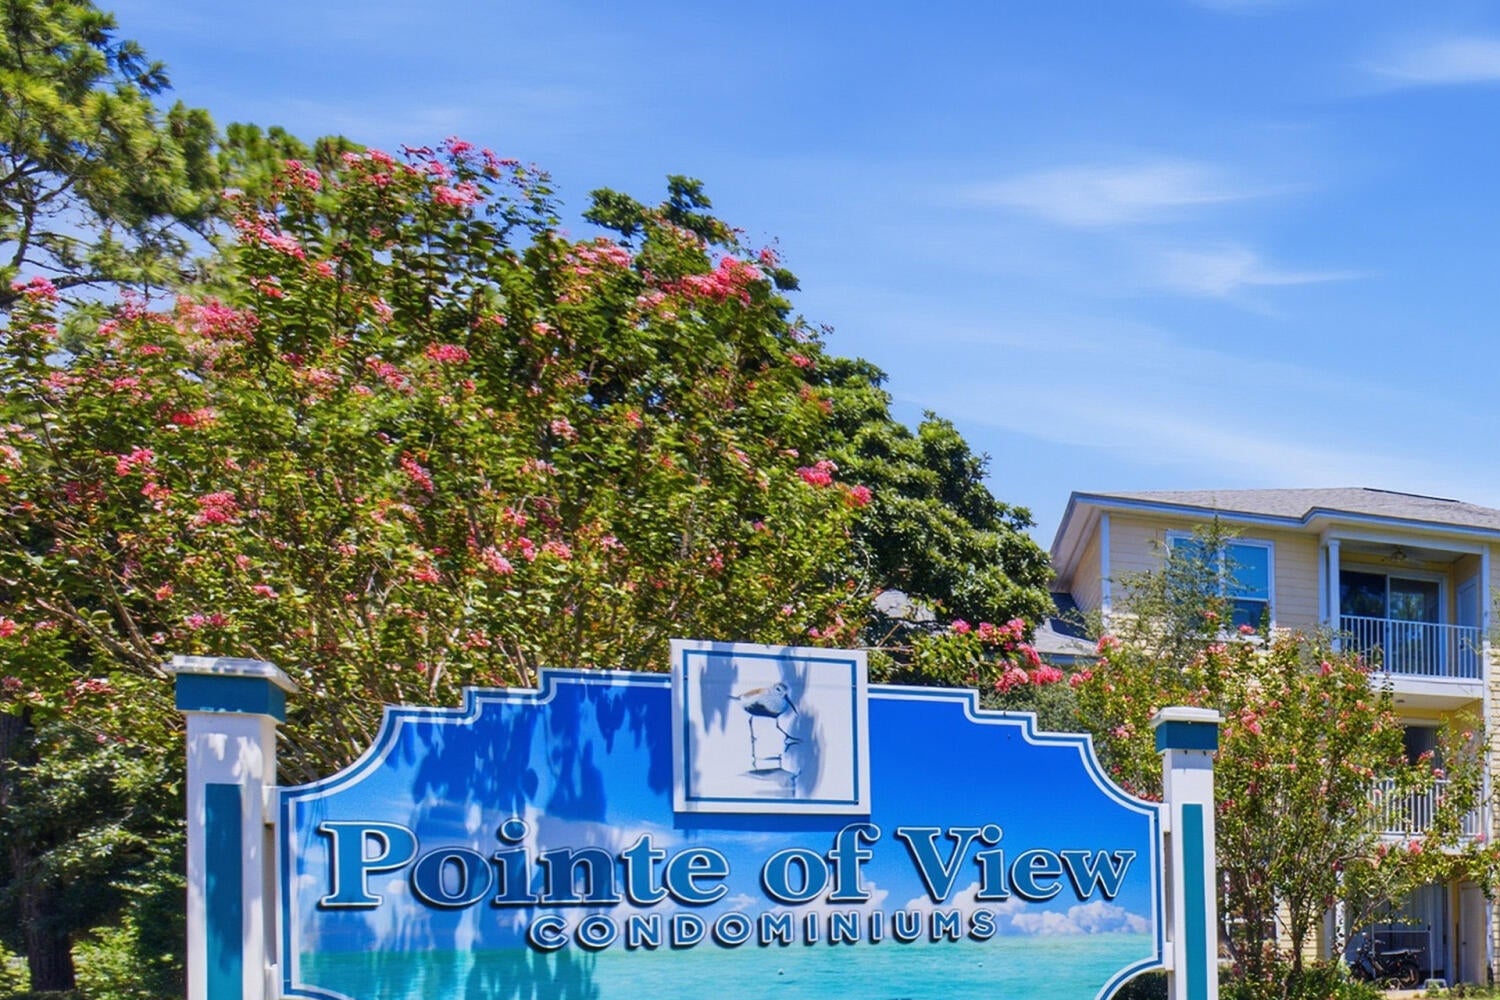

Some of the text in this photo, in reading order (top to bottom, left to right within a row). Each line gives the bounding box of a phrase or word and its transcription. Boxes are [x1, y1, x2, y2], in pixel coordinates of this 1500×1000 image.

[318, 818, 1137, 909] Pointe of View
[527, 909, 997, 951] CONDOMINIUMS
